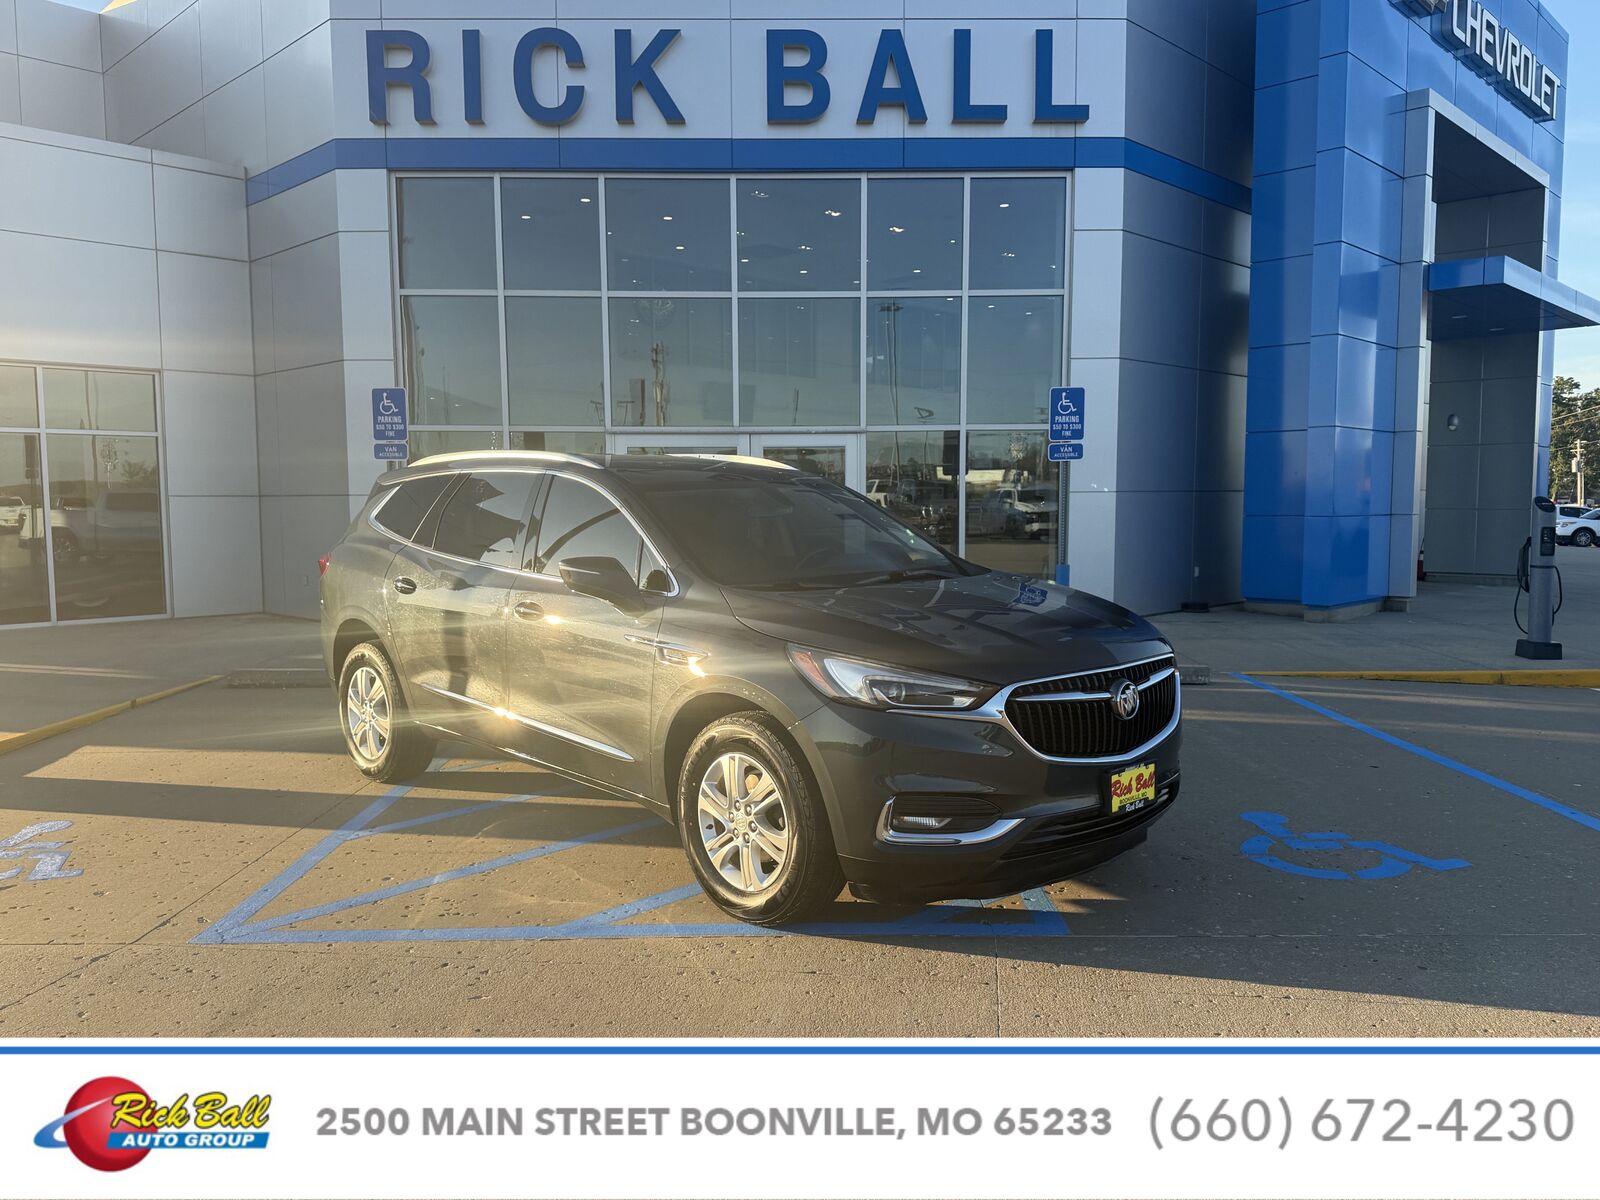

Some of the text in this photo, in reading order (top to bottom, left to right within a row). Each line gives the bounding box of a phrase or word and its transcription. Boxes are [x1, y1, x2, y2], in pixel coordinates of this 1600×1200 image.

[365, 28, 1090, 125] RICK BALL
[1452, 0, 1561, 120] CHEVROLET
[1054, 415, 1080, 423] PARKING
[1111, 770, 1156, 798] Rick Ball
